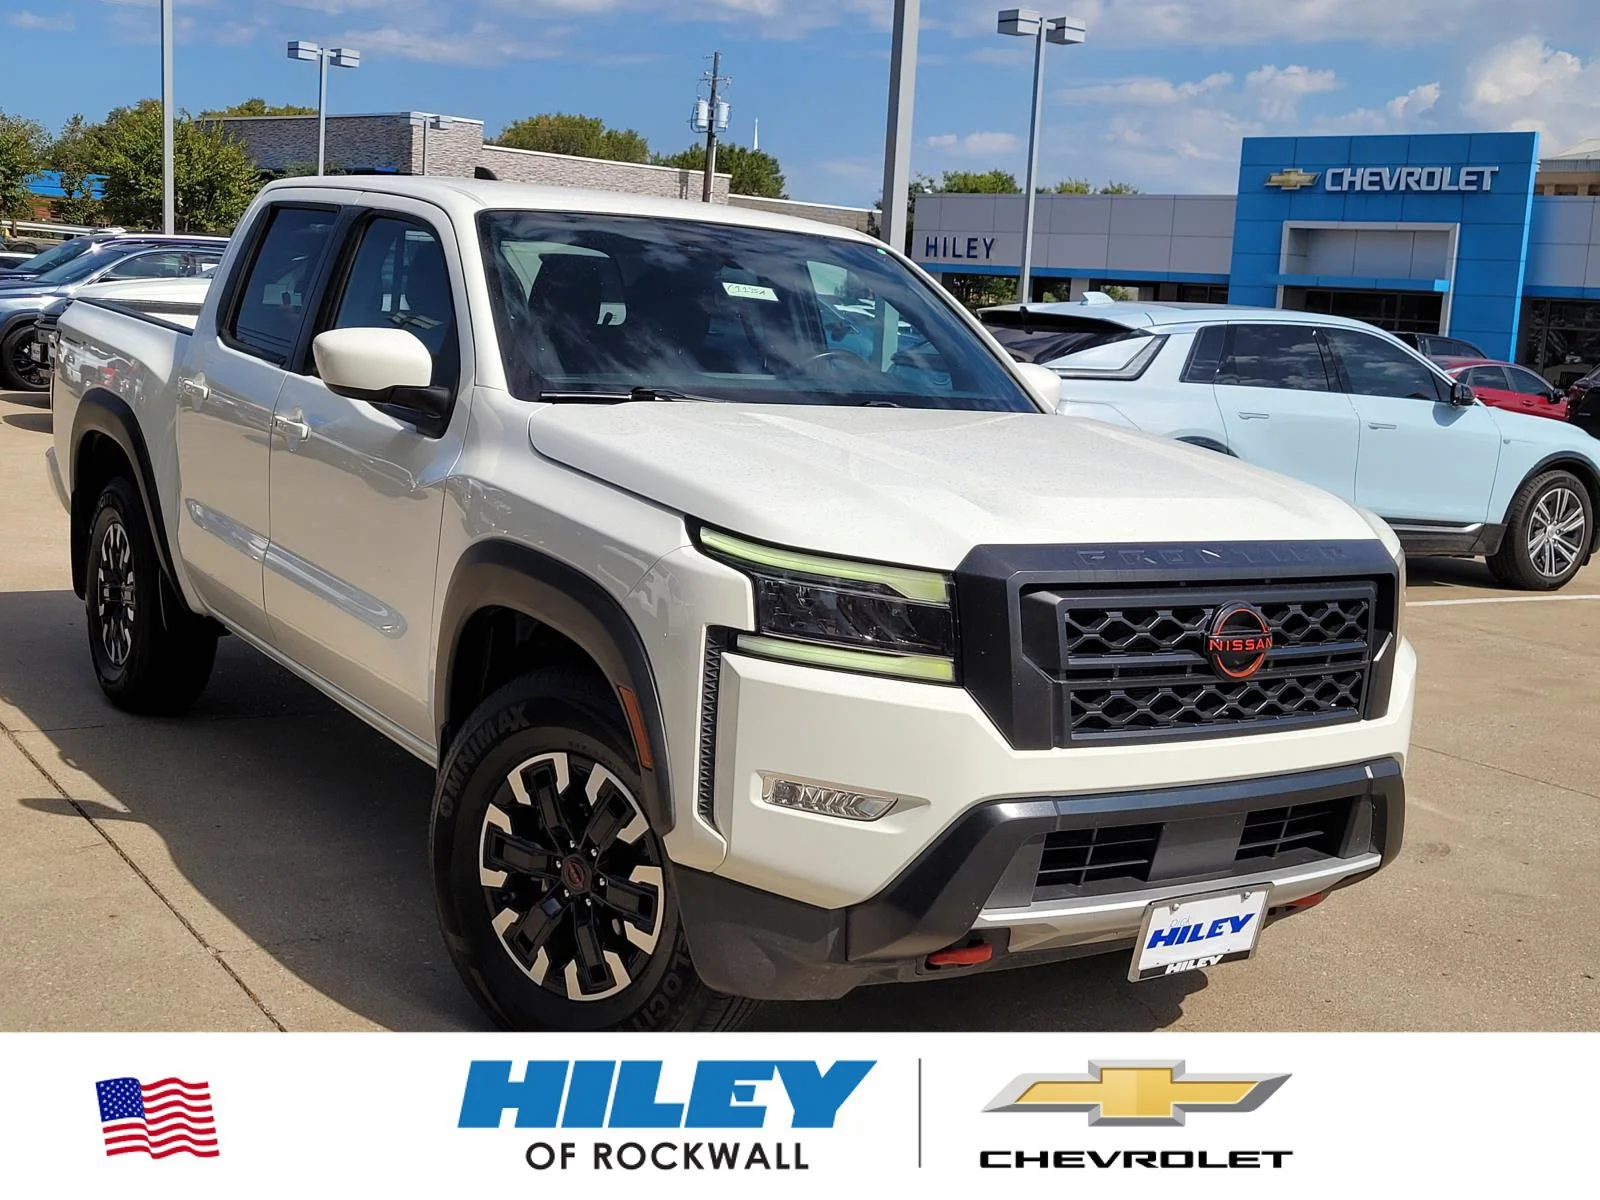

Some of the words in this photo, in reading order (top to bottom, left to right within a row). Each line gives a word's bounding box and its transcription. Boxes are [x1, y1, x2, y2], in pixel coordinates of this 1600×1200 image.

[1325, 166, 1499, 192] CHEVROLET
[925, 236, 995, 261] HILEY
[1208, 637, 1273, 652] NISSAN
[1147, 912, 1256, 950] HILEY
[1165, 954, 1224, 975] HILEY
